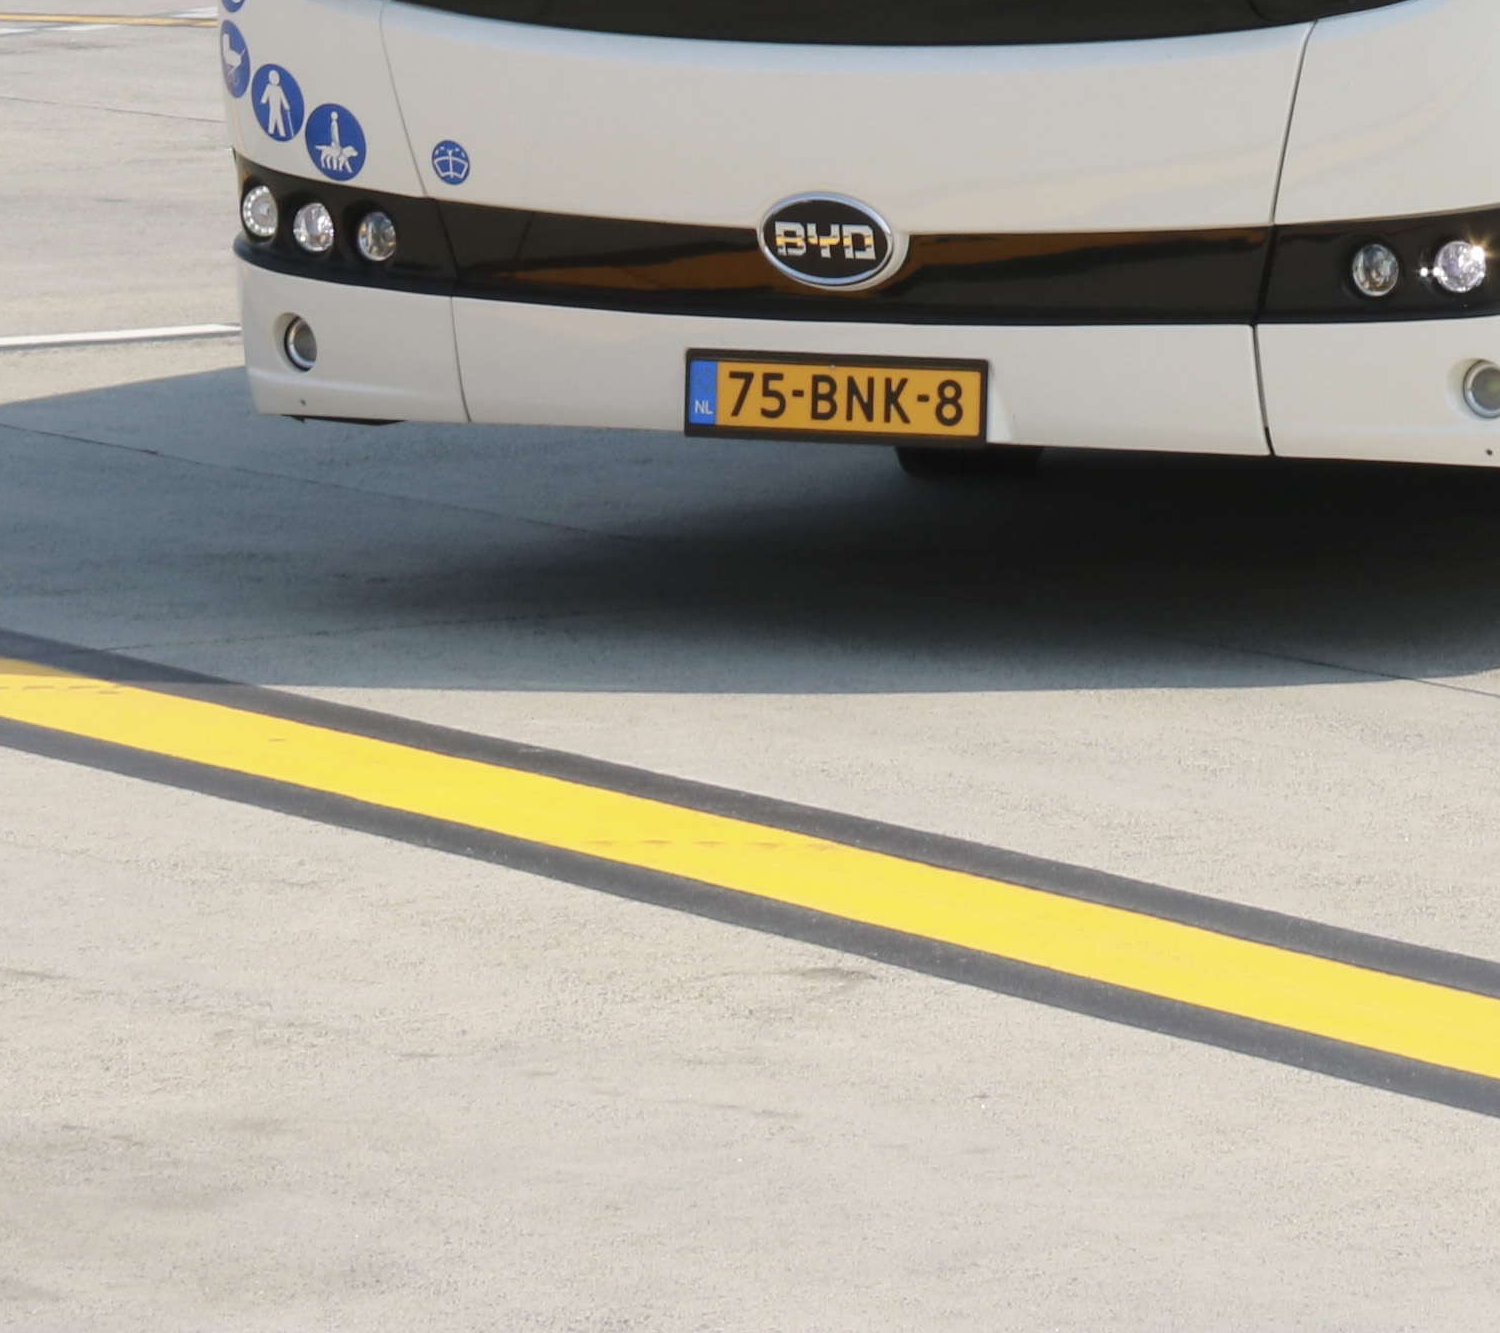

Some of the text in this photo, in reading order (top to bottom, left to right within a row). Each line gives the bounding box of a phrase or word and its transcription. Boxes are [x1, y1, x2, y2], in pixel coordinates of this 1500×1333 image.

[775, 220, 876, 261] BYD
[694, 399, 713, 415] NL
[728, 370, 964, 427] 75-BNK-8
